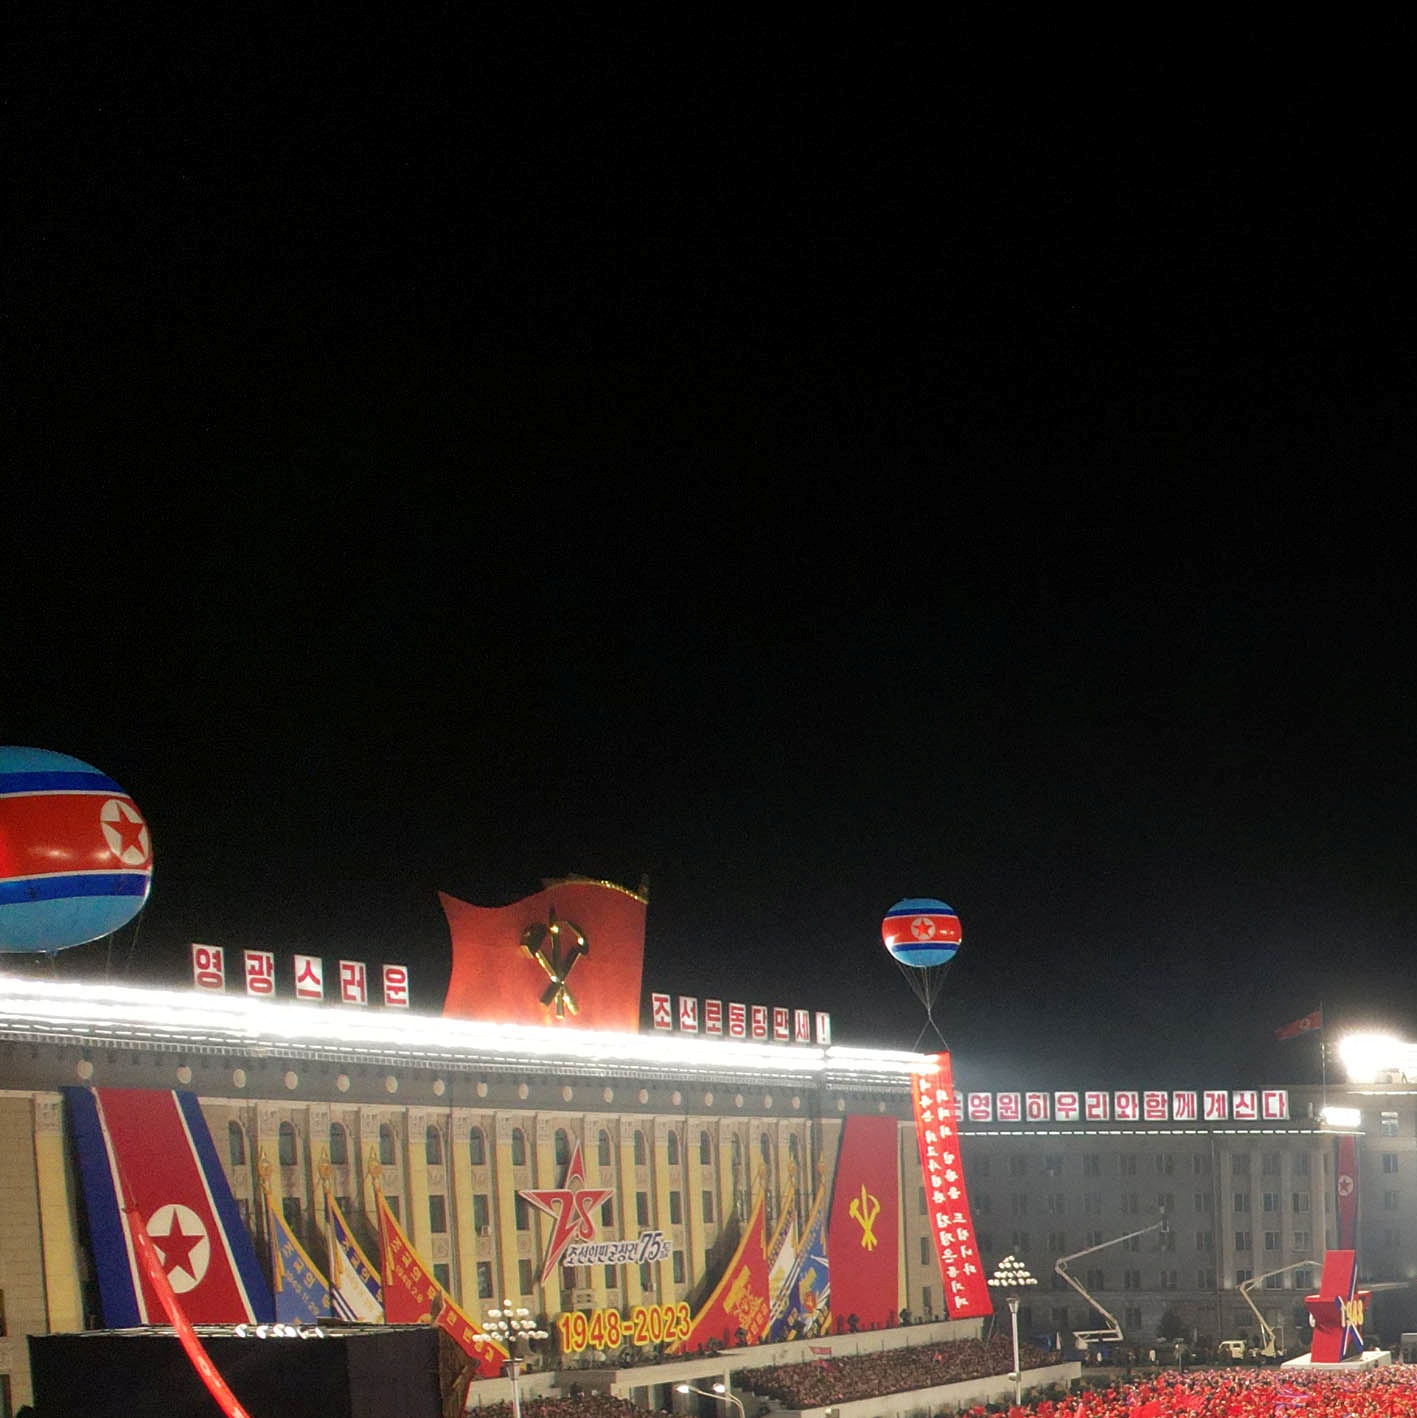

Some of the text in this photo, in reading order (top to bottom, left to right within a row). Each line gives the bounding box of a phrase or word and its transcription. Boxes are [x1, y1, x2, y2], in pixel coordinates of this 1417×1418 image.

[195, 947, 408, 1006] 영광스러운
[653, 995, 827, 1042] 조선로동당만세!
[559, 1301, 693, 1350] 1948-2023
